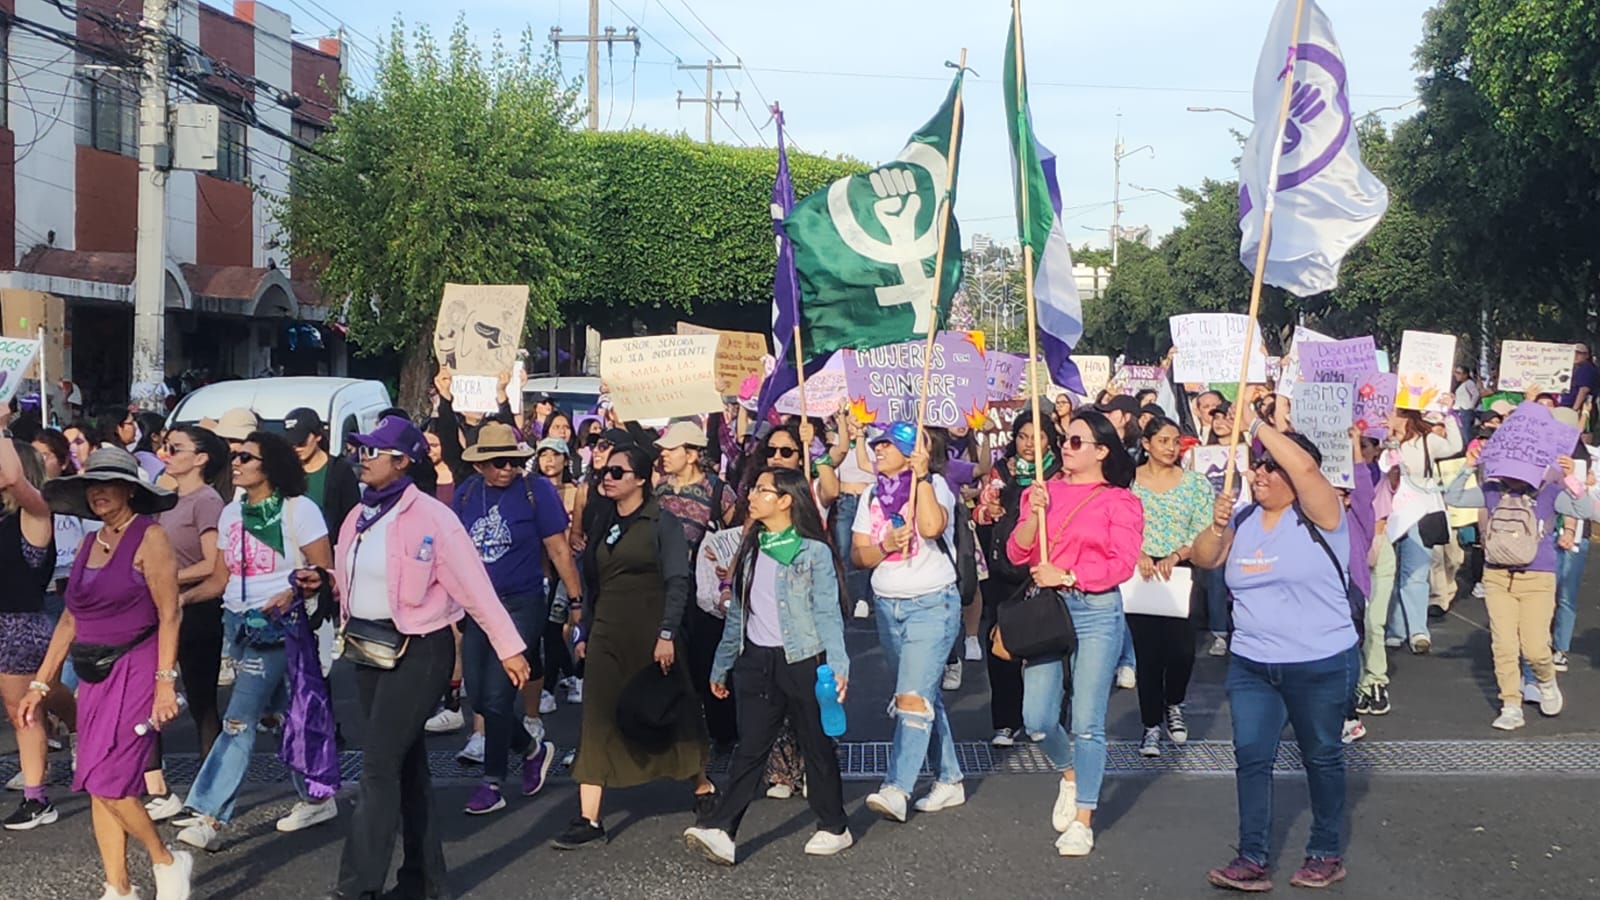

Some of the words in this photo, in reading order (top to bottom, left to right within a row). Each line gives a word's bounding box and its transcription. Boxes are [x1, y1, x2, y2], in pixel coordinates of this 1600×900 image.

[609, 355, 623, 364] NO
[628, 353, 644, 362] SEA
[855, 343, 945, 370] MUJERES
[631, 366, 660, 377] MATA
[678, 361, 696, 370] LAS
[1133, 368, 1155, 379] NOS
[869, 371, 956, 397] SANGRE
[1296, 414, 1318, 430] hoy
[1322, 416, 1342, 426] con
